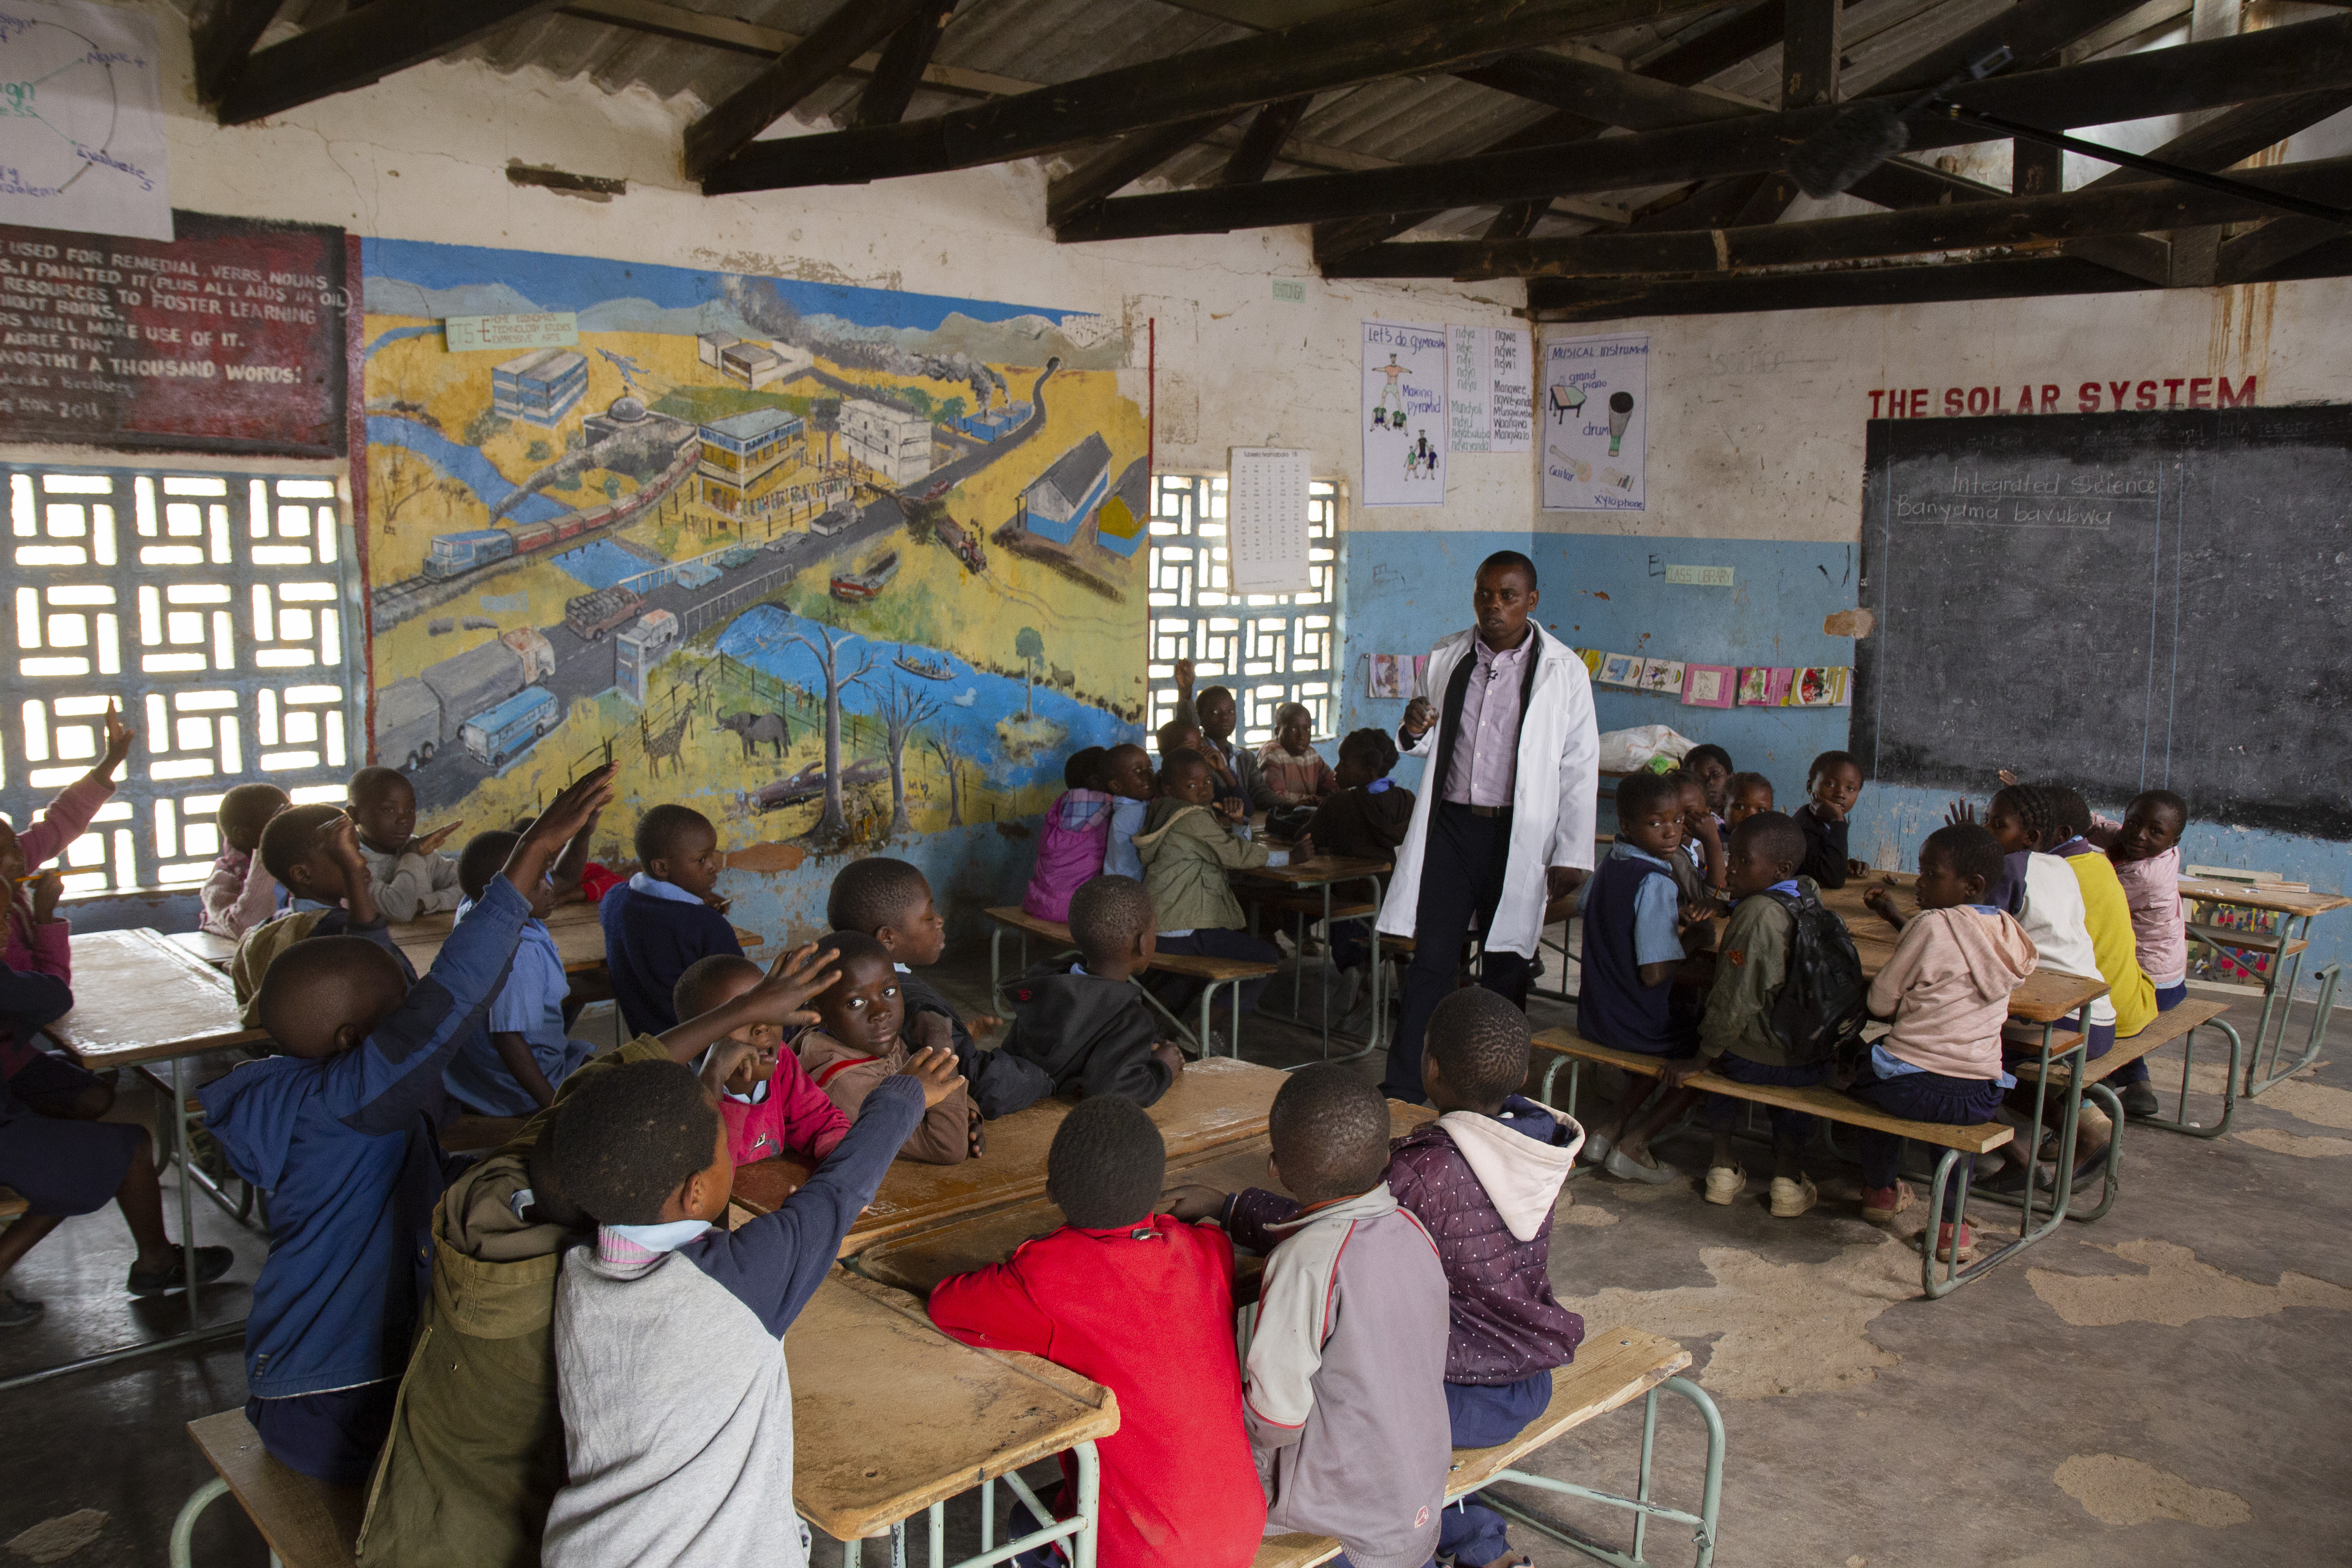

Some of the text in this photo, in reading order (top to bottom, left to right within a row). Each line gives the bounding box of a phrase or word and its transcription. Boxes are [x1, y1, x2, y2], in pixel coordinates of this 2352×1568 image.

[9, 241, 59, 259] USED
[67, 248, 103, 265] FOR
[112, 254, 199, 277] REMEDIAL
[270, 272, 328, 290] NOUNS
[35, 262, 122, 284] PAINTED
[132, 274, 147, 288] IT
[204, 281, 237, 297] ALL
[3, 276, 316, 325] RESOURCES TO FOSTER LEARNING
[4, 332, 113, 354] AGREE THAT
[87, 320, 137, 340] MAKE
[145, 325, 181, 343] USE
[191, 332, 214, 347] OF
[448, 322, 475, 345] CTS
[1368, 327, 1392, 343] Let's
[1395, 330, 1407, 347] do
[1552, 347, 1594, 360] MUSICAL
[88, 356, 104, 372] A
[108, 358, 216, 378] THOUSAND
[1569, 370, 1597, 385] grand
[1402, 383, 1432, 405] Making
[1582, 379, 1607, 393] piano
[1867, 375, 2258, 419] THE SOLAR SYSTEM
[1406, 395, 1441, 416] pyramid
[1583, 421, 1610, 436] drum
[1952, 466, 2158, 503] Integrated Science
[1897, 494, 1999, 525] Banyama
[1666, 567, 1732, 584] CLASS LIBRARY
